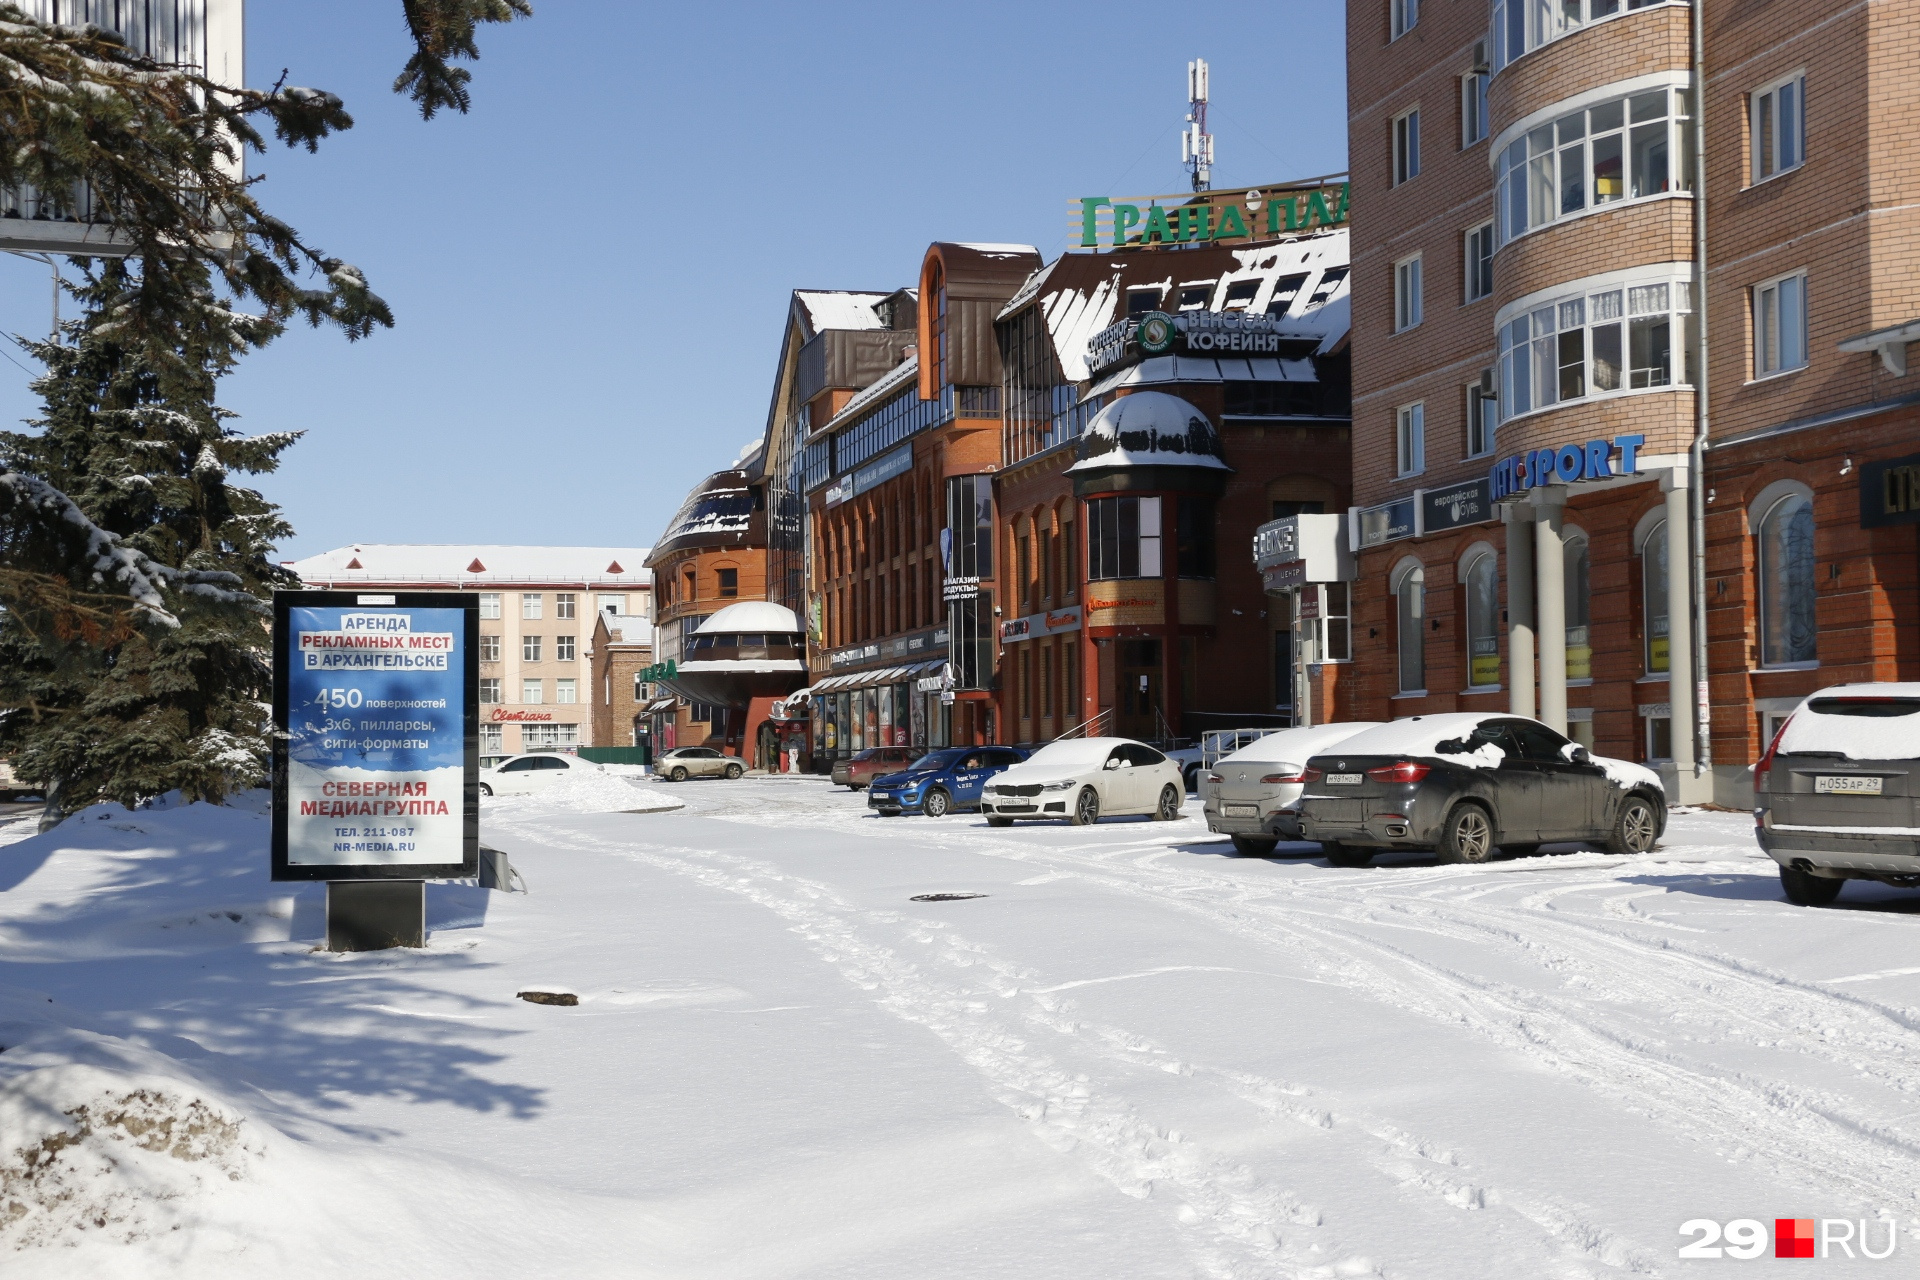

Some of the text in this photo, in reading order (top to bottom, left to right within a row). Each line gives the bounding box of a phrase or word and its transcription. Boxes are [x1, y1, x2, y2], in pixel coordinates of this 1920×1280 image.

[1081, 197, 1249, 247] ГРАНД
[1141, 313, 1171, 327] COFFEESHOP
[1188, 310, 1276, 329] ВЕНСКАЯ
[1087, 318, 1129, 353] COFFEESHOP
[1187, 330, 1278, 351] КОФЕЙНЯ
[1143, 341, 1168, 351] COMPANY
[1091, 341, 1124, 372] COMPANY
[1524, 434, 1644, 490] SPORT
[1434, 489, 1478, 507] европейская
[345, 617, 408, 631] АРЕНДА
[302, 635, 451, 649] РЕКЛАМНЫХ МЕСТ
[307, 654, 445, 667] В АРХАНГЕЛЬСКЕ
[314, 688, 363, 709] 450
[366, 698, 446, 709] поверхностей
[491, 708, 552, 721] Светлана
[360, 720, 436, 733] пилларсы,
[324, 737, 429, 751] сити-форматы
[322, 781, 427, 797] СЕВЕРНАЯ
[1819, 778, 1878, 789] Н055АР 29
[300, 800, 449, 818] МЕДИАГРУППА
[335, 828, 414, 837] ТЕЛ. 211-087
[333, 842, 415, 852] NR-MEDIA.RU
